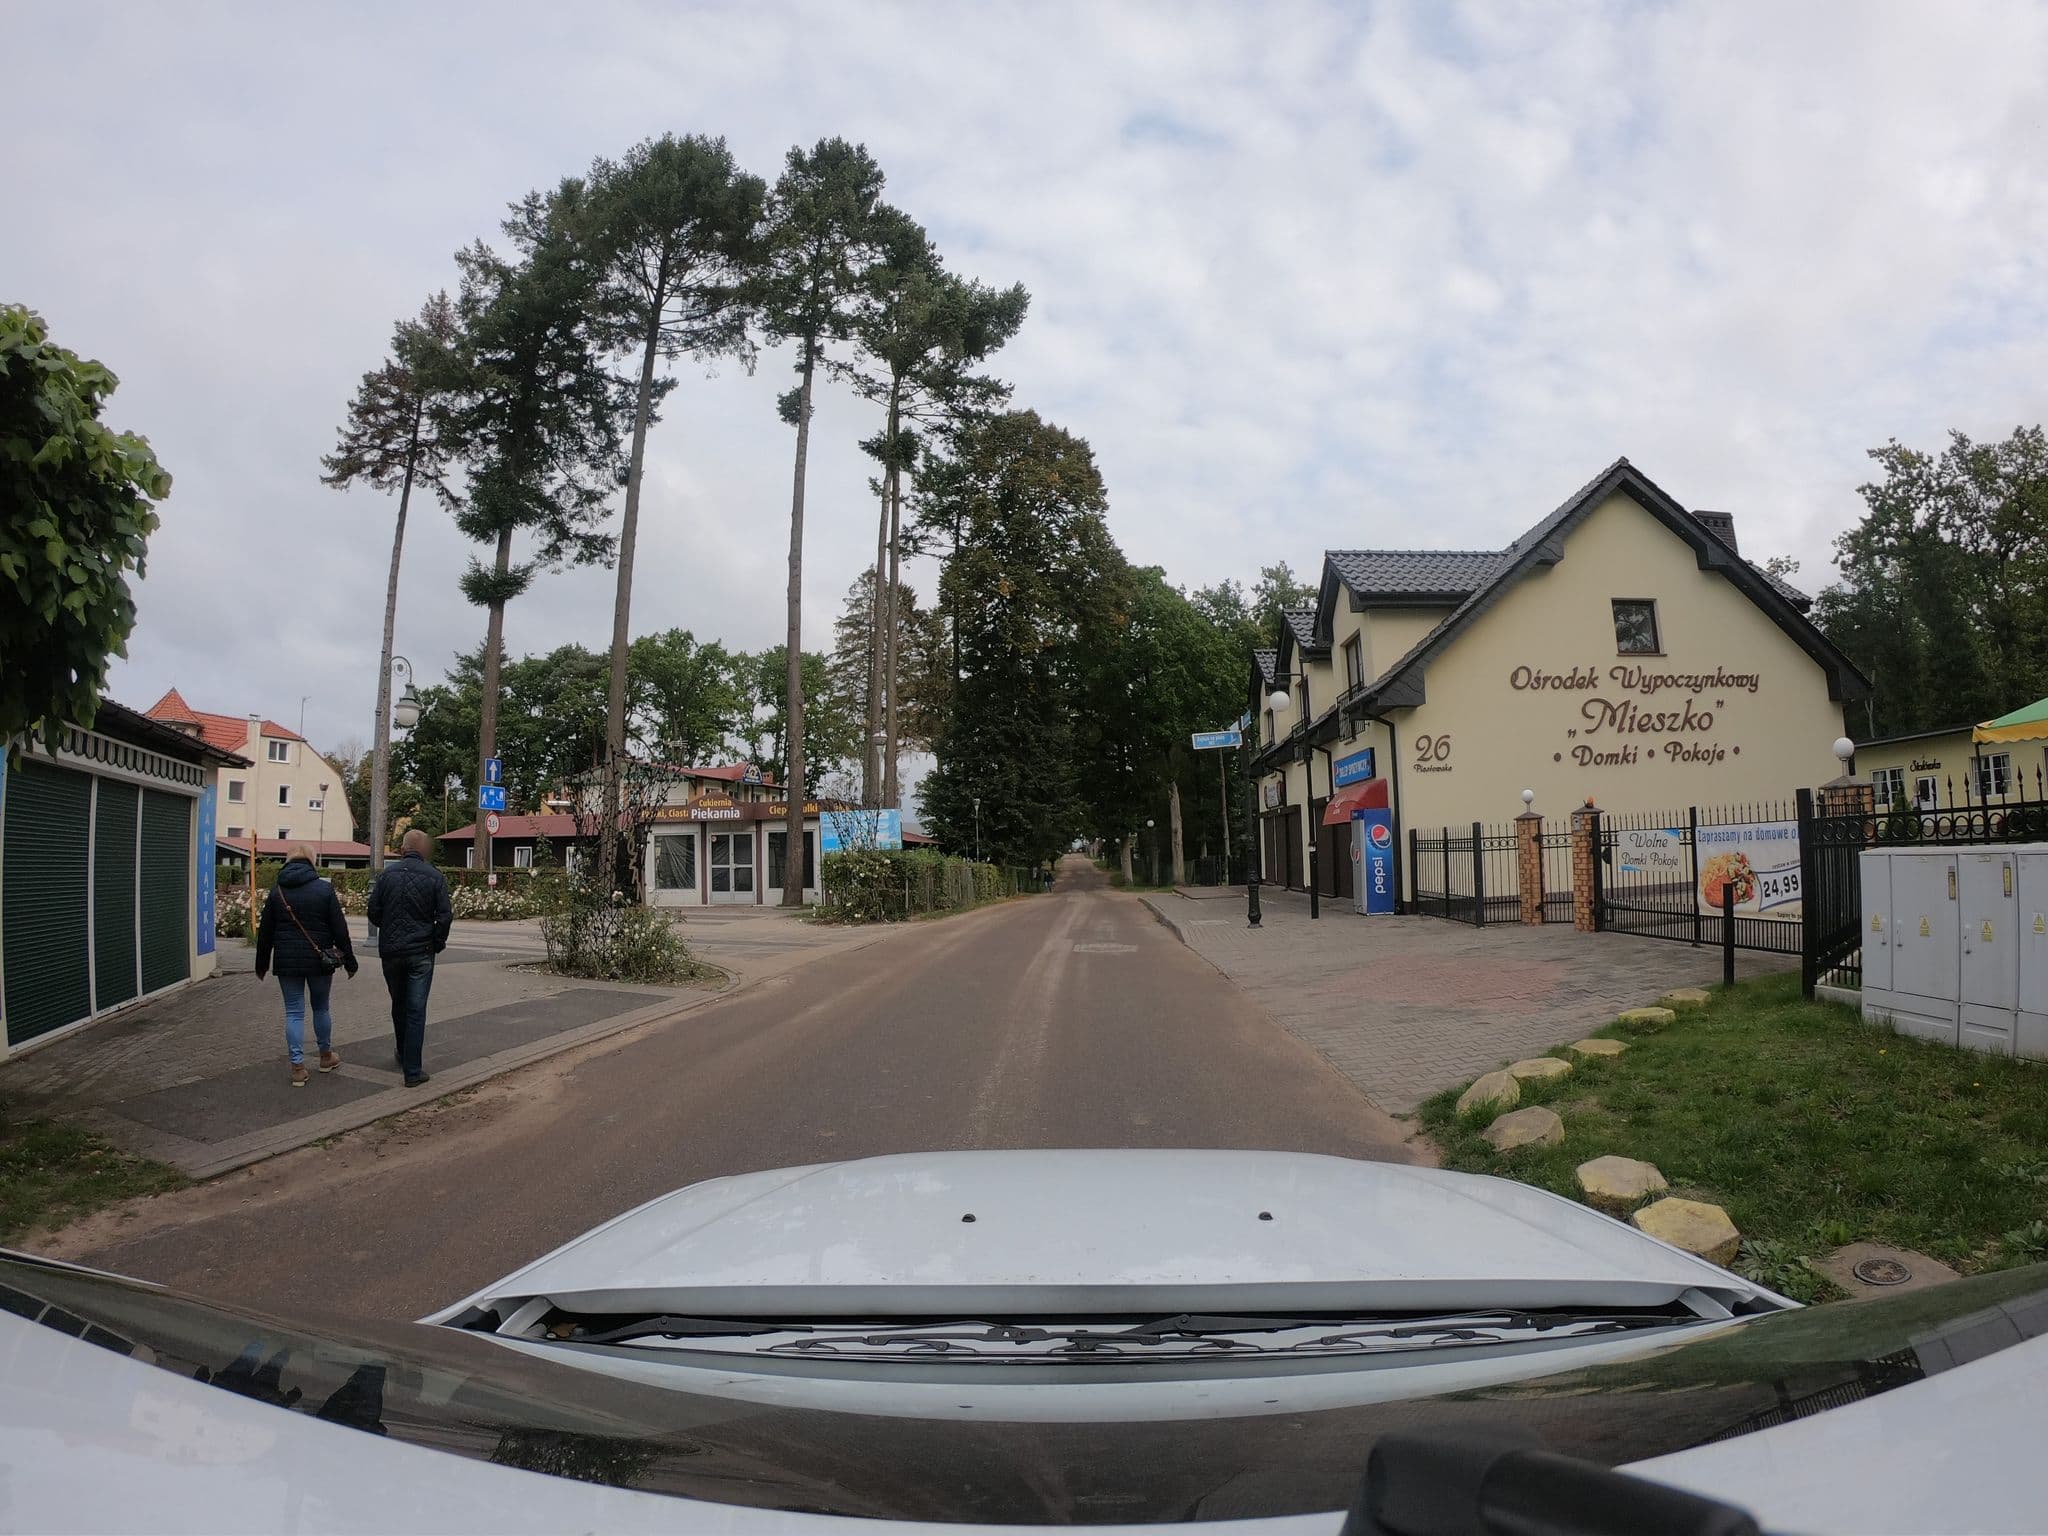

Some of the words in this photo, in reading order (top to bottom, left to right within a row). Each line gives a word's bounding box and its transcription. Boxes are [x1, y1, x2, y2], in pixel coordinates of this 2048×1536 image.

[1510, 665, 1598, 690] Ośrodek
[1609, 665, 1760, 695] Wypoczynkowy
[1415, 734, 1451, 762] 26
[1571, 744, 1638, 766] Domki
[1664, 741, 1725, 765] Pokoje
[699, 798, 732, 807] Cukiernia
[691, 807, 740, 819] Piekarnia
[1629, 832, 1668, 848] Wolne
[1698, 830, 1741, 844] Zapraszamy
[1743, 831, 1753, 841] na
[1755, 827, 1789, 841] domowe
[1621, 852, 1647, 865] Domki
[1650, 853, 1679, 868] Pokoje
[1372, 857, 1387, 894] pepsi
[1763, 874, 1799, 898] 24,99
